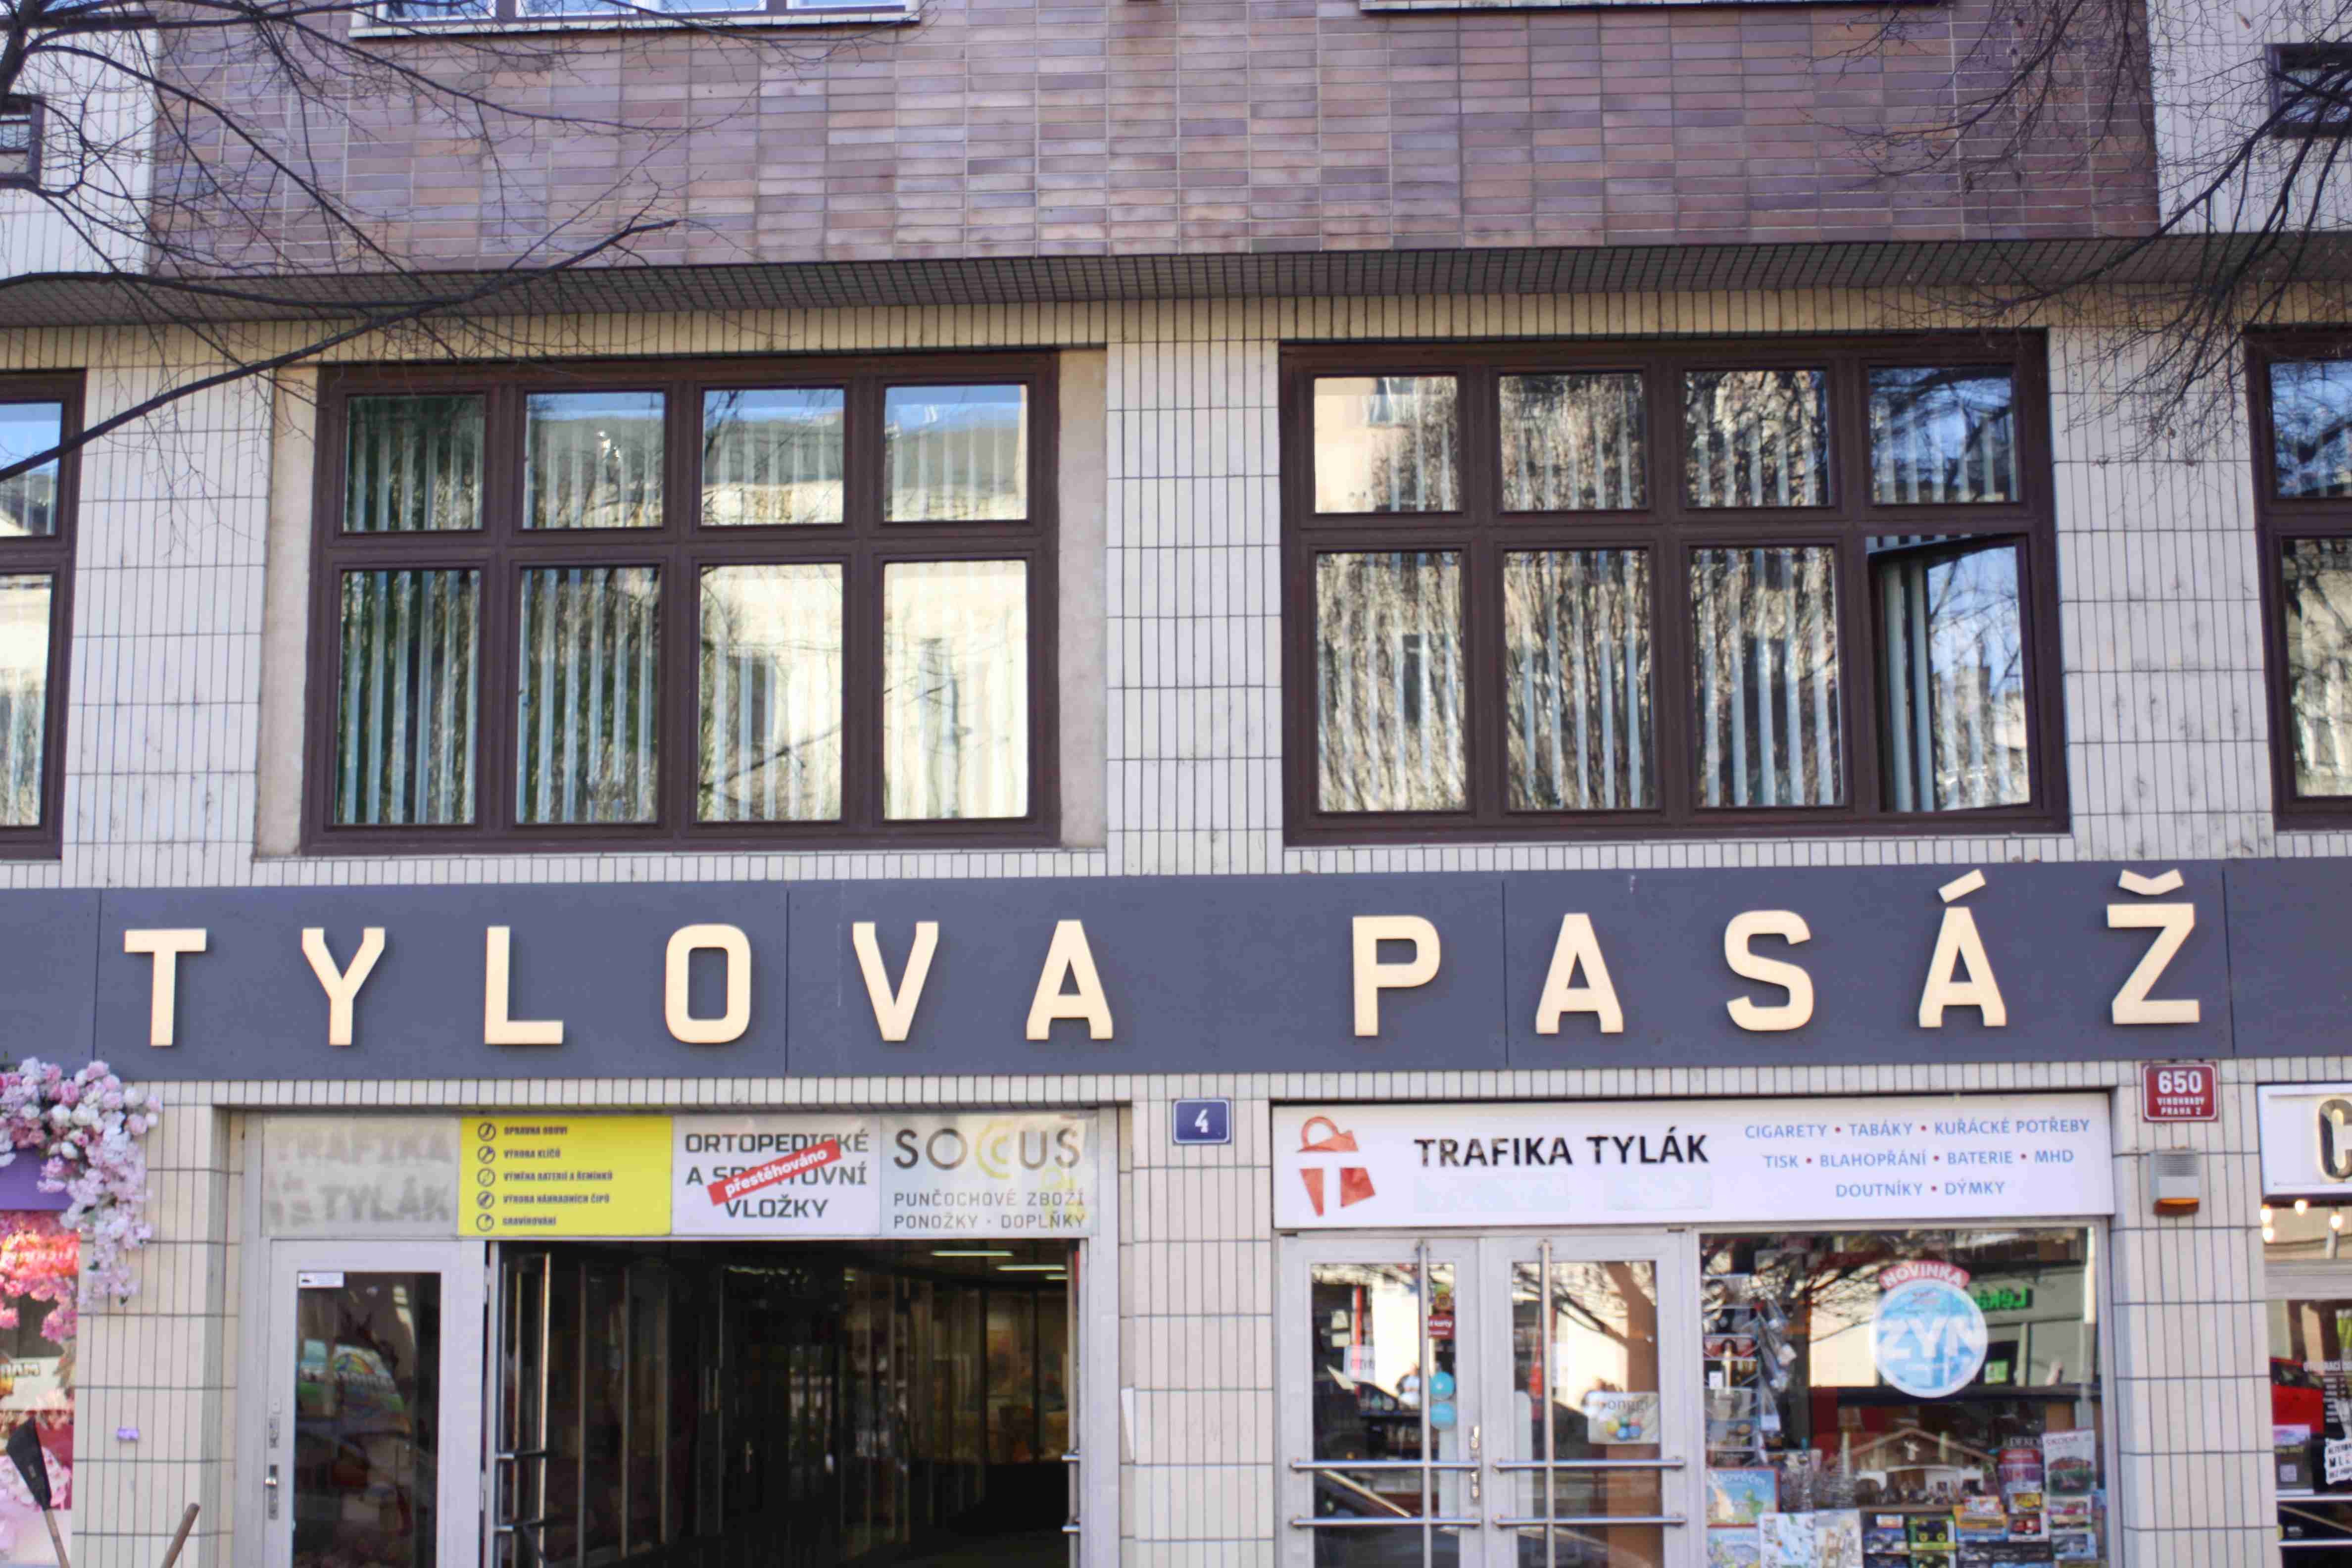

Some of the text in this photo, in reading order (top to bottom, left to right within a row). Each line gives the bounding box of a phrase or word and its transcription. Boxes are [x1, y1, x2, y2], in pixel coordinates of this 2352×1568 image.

[124, 869, 2201, 1046] TYLOVA PASÁŽ
[2158, 1071, 2202, 1094] 650
[2156, 1097, 2205, 1106] VINOHRADY
[2161, 1107, 2202, 1116] PRAHA 2
[504, 1127, 540, 1135] OPRAVNA
[1195, 1109, 1209, 1133] 4
[1745, 1115, 2091, 1138] CIGARETY TABÁKY KUŘÁCKÉ POTŘEBY
[503, 1148, 561, 1159] VÝROBA KLÍČŮ
[893, 1120, 1080, 1179] SOCCUS
[1415, 1126, 1709, 1167] TRAFIKA TYLÁK
[1762, 1149, 2074, 1168] TISK BLAHOPŘÁNÍ BATERIE MHD
[503, 1171, 536, 1181] VÝMĚNA
[686, 1167, 703, 1185] A
[724, 1149, 828, 1197] přestěhováno
[894, 1188, 1085, 1207] PUNČOCHOVÉ ZBOŽÍ
[1835, 1177, 2005, 1198] DOUTNÍKY DÝMKY
[503, 1193, 610, 1204] VÝROBA NÁHRADNÍCH ČIPŮ
[726, 1194, 829, 1218] VLOŽKY
[894, 1210, 1085, 1229] PONOŽKY DOPLŇKY
[1883, 1263, 1962, 1286] NOVINKA
[1880, 1315, 1984, 1359] ZYN
